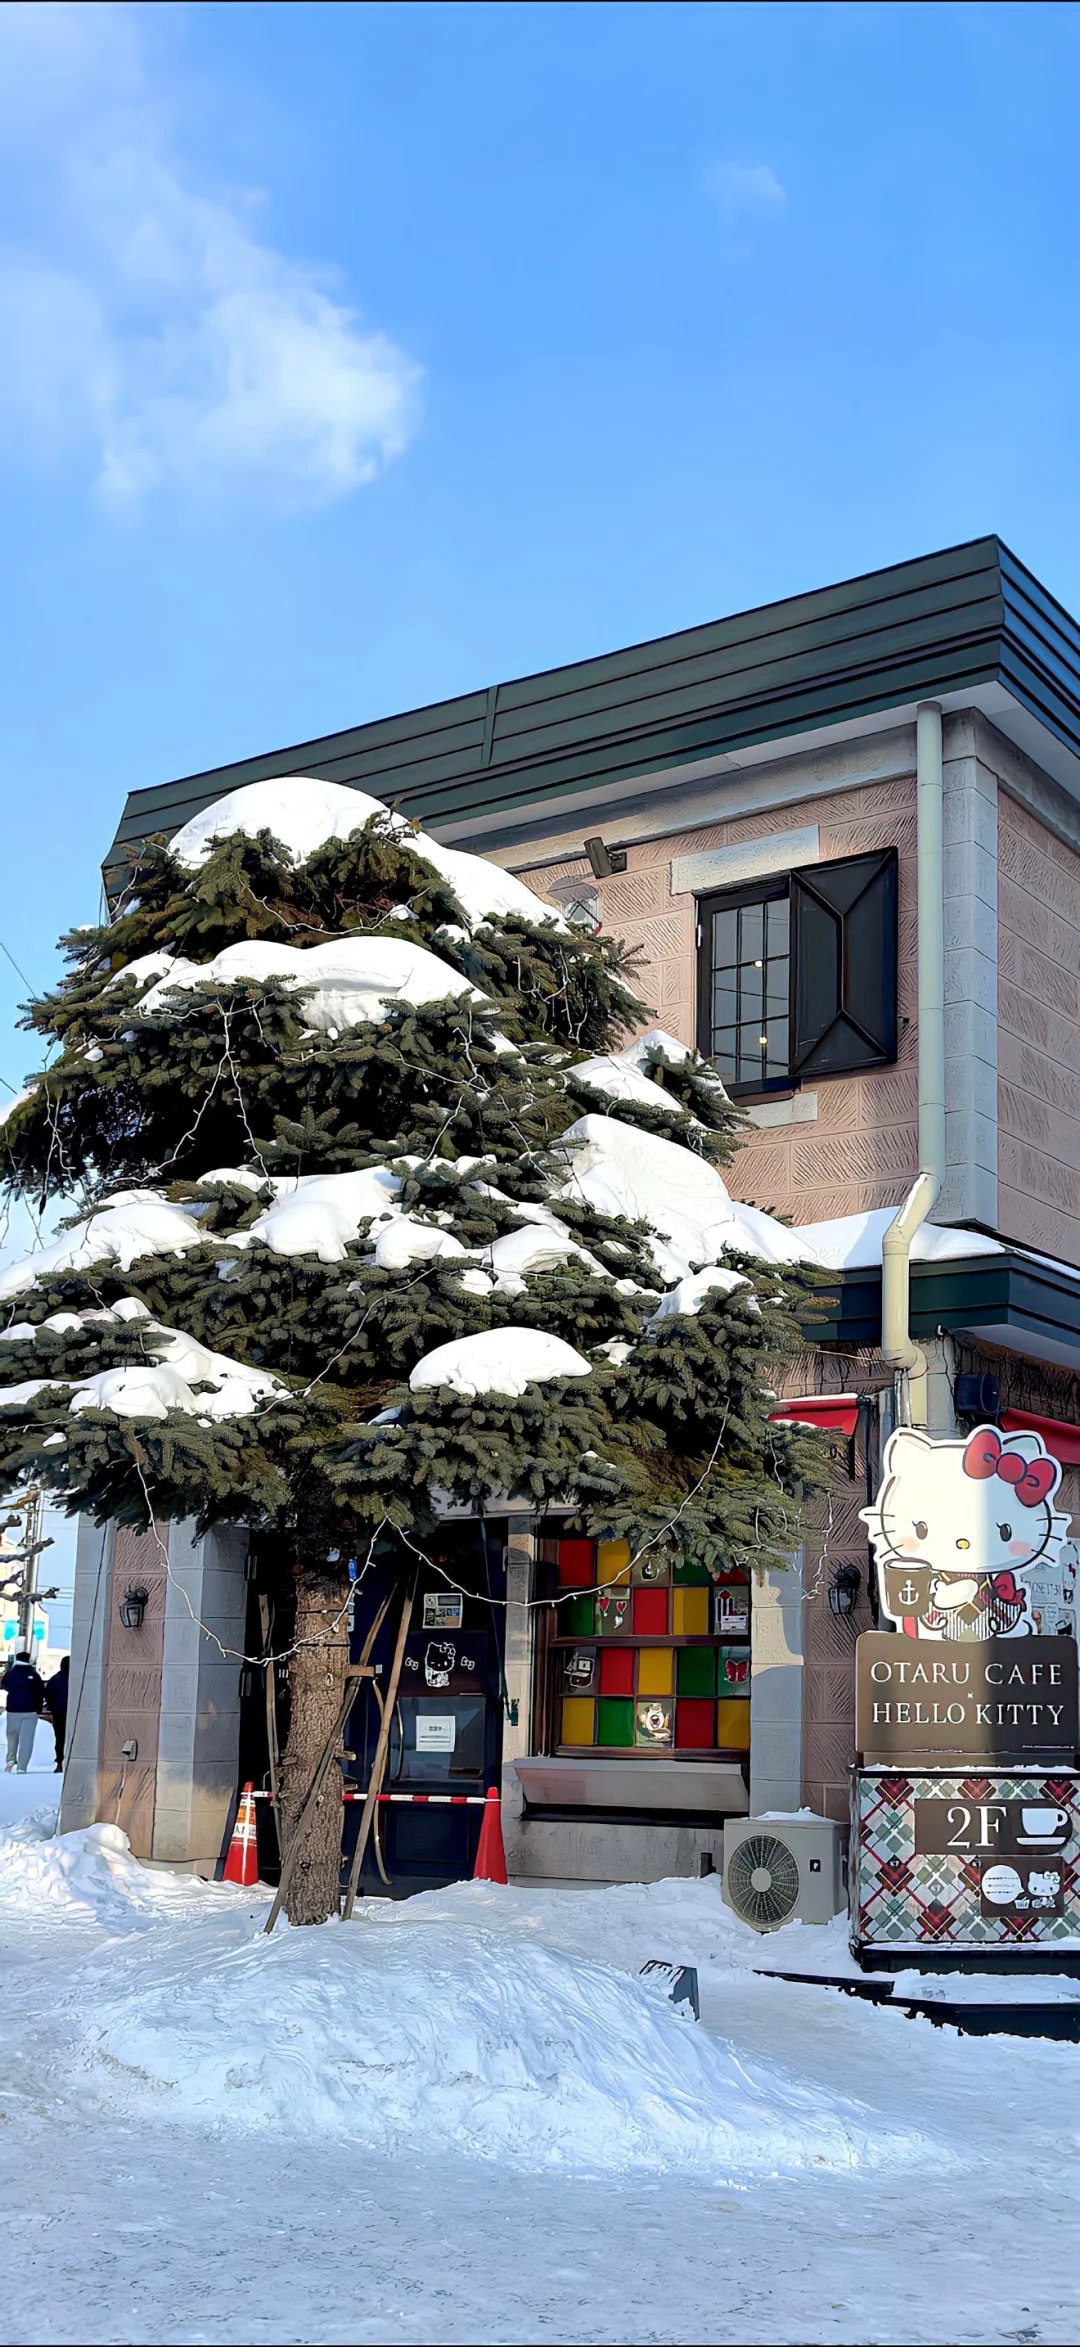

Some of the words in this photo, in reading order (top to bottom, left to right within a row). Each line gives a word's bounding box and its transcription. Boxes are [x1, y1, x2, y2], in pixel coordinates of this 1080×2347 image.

[870, 1661, 970, 1685] OTARU
[984, 1662, 1062, 1686] CAFE
[872, 1702, 966, 1725] HELLO
[975, 1703, 1065, 1726] KITTY
[946, 1805, 1007, 1850] 2F
